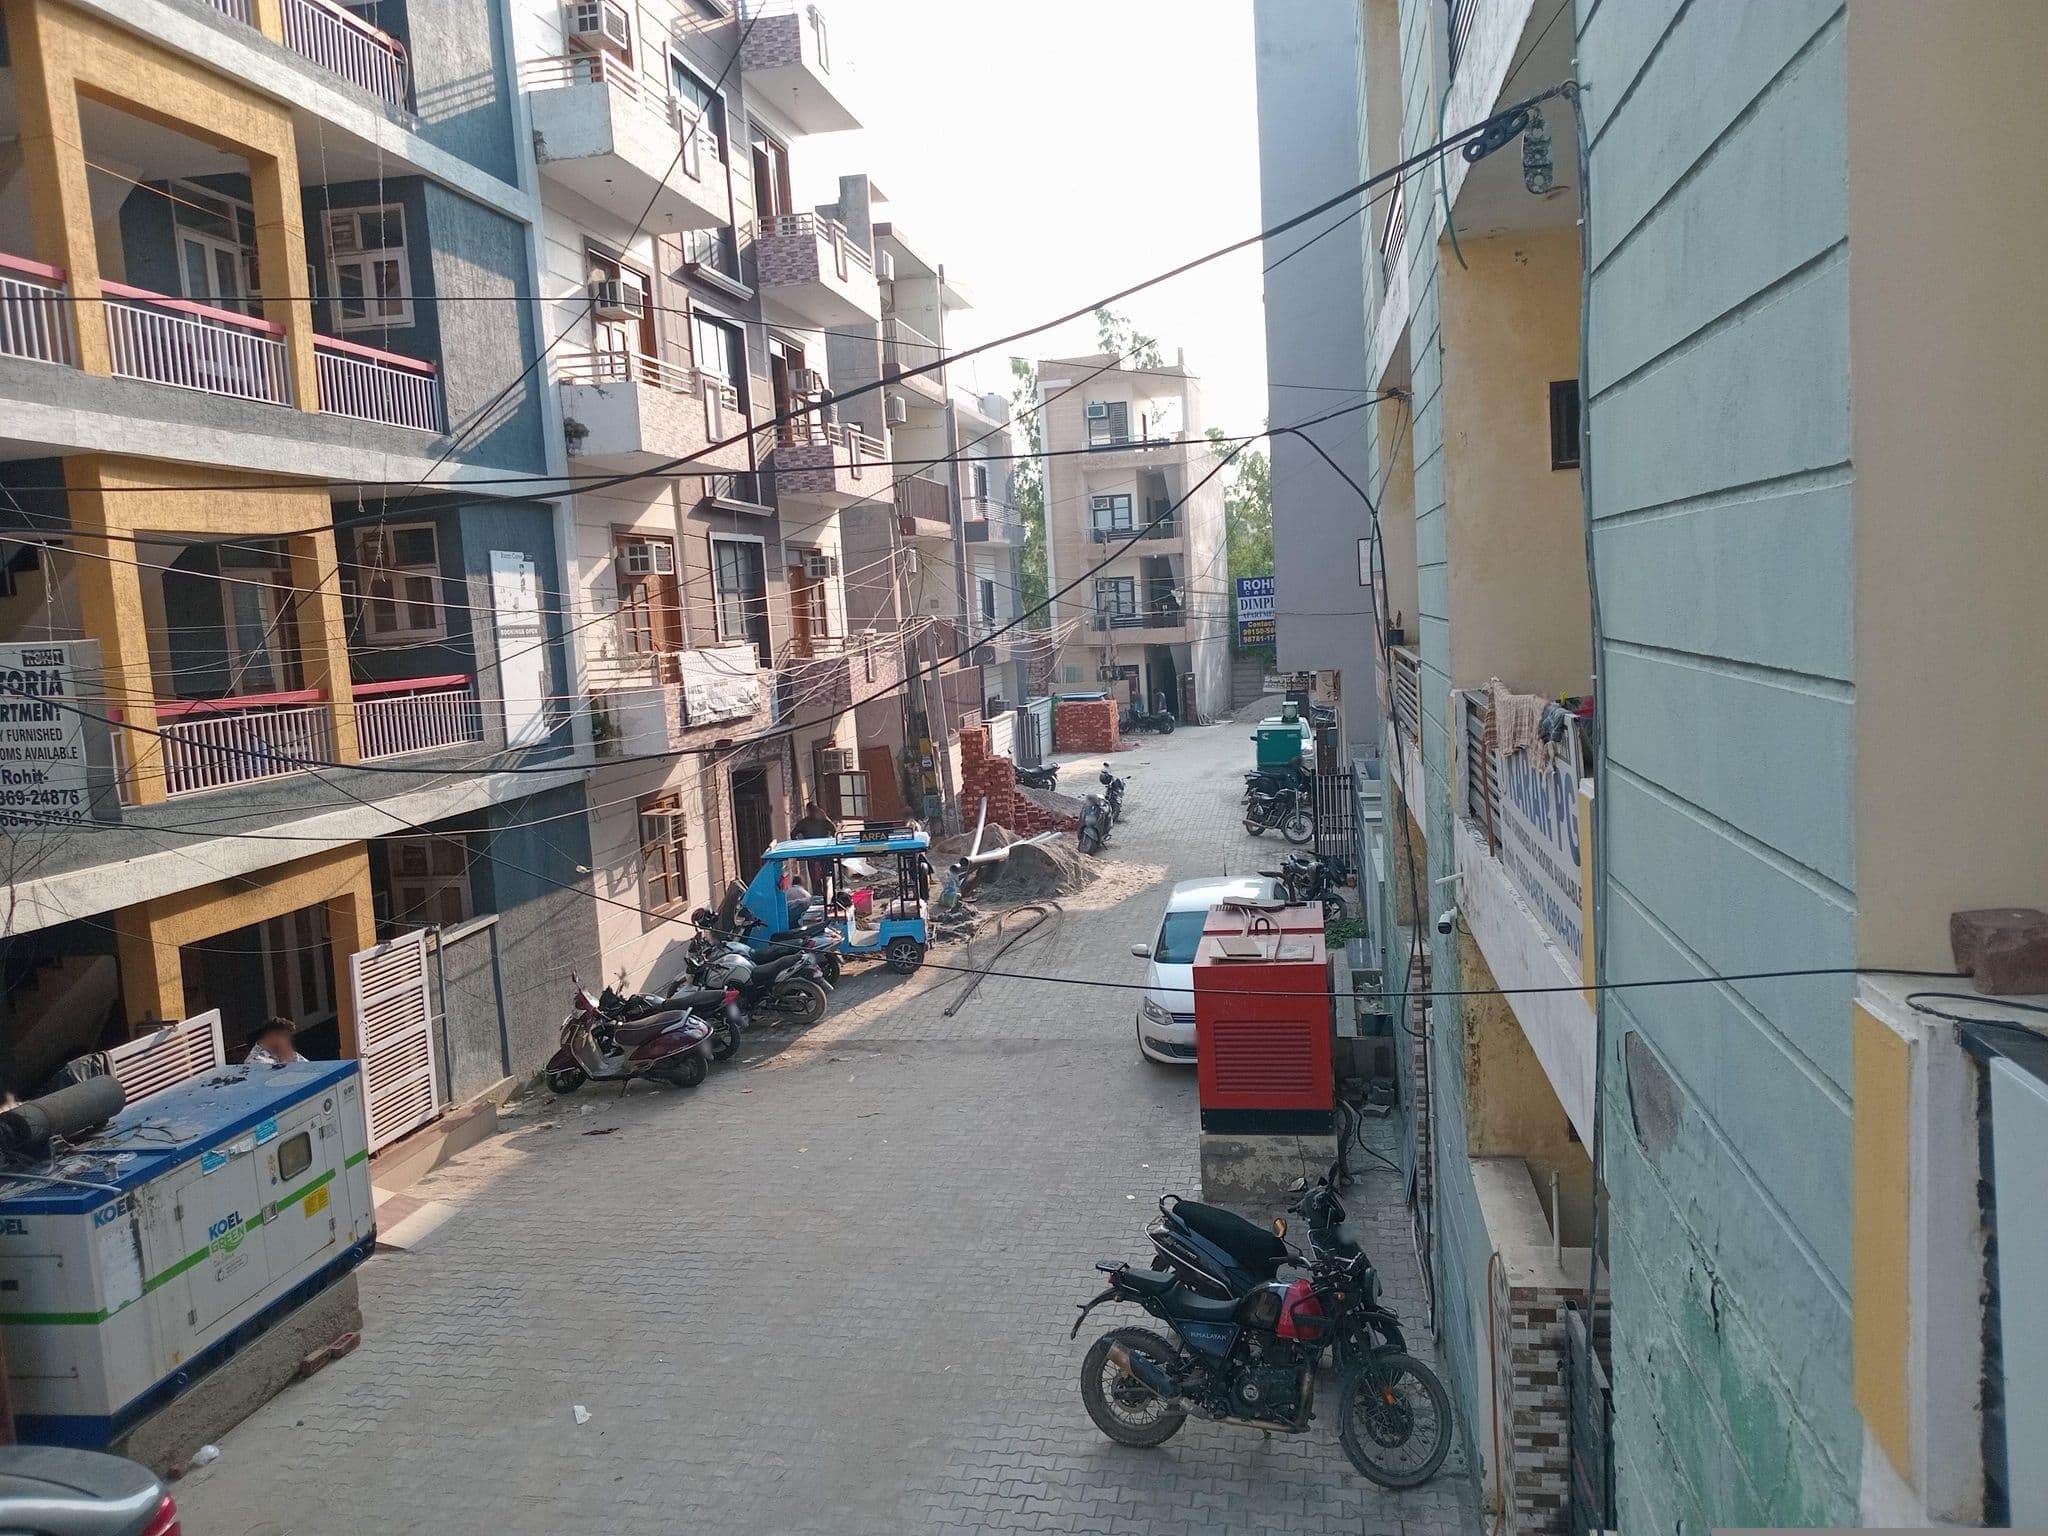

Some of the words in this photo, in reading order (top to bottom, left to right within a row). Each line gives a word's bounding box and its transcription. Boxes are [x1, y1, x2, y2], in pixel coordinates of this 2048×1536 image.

[7, 728, 62, 743] FURNISHED
[25, 746, 79, 760] AVAILABLE
[1553, 764, 1581, 867] PG
[862, 832, 887, 841] ARFA
[208, 1210, 243, 1241] KOEL
[210, 1223, 246, 1253] GREEN
[1190, 1331, 1227, 1341] HIMALAYAN
